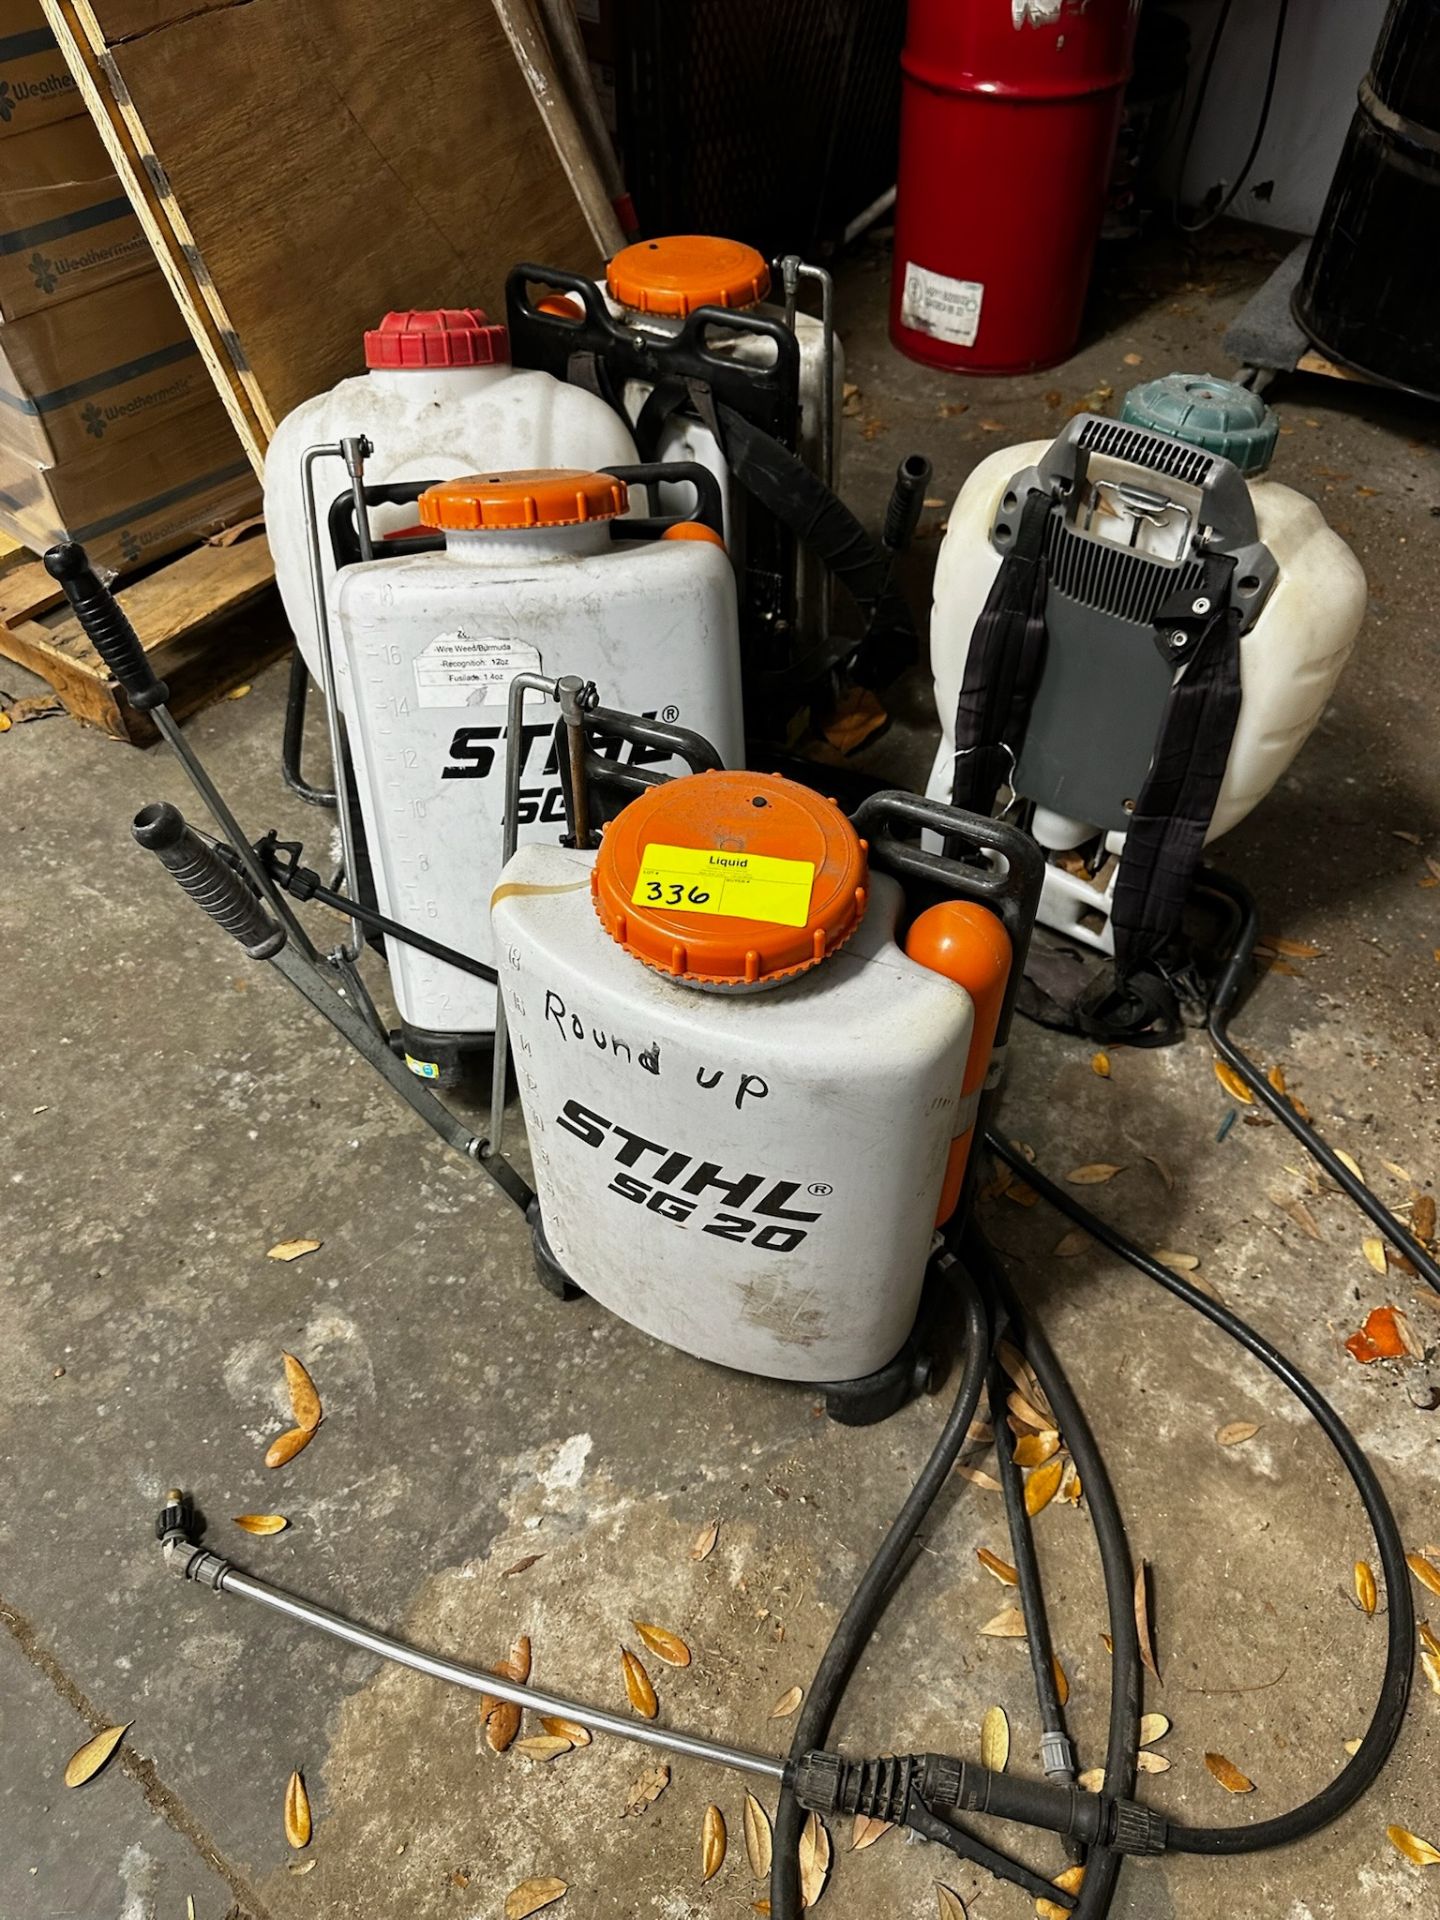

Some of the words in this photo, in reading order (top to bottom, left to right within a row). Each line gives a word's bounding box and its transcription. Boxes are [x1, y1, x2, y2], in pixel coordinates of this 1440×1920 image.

[382, 644, 402, 666] 16
[389, 696, 410, 718] 14
[400, 747, 418, 769] 12
[709, 855, 748, 868] Liquid
[646, 881, 710, 905] 336
[545, 989, 661, 1075] Round
[696, 1066, 769, 1110] up
[607, 1172, 699, 1222] SG
[701, 1212, 808, 1253] 20
